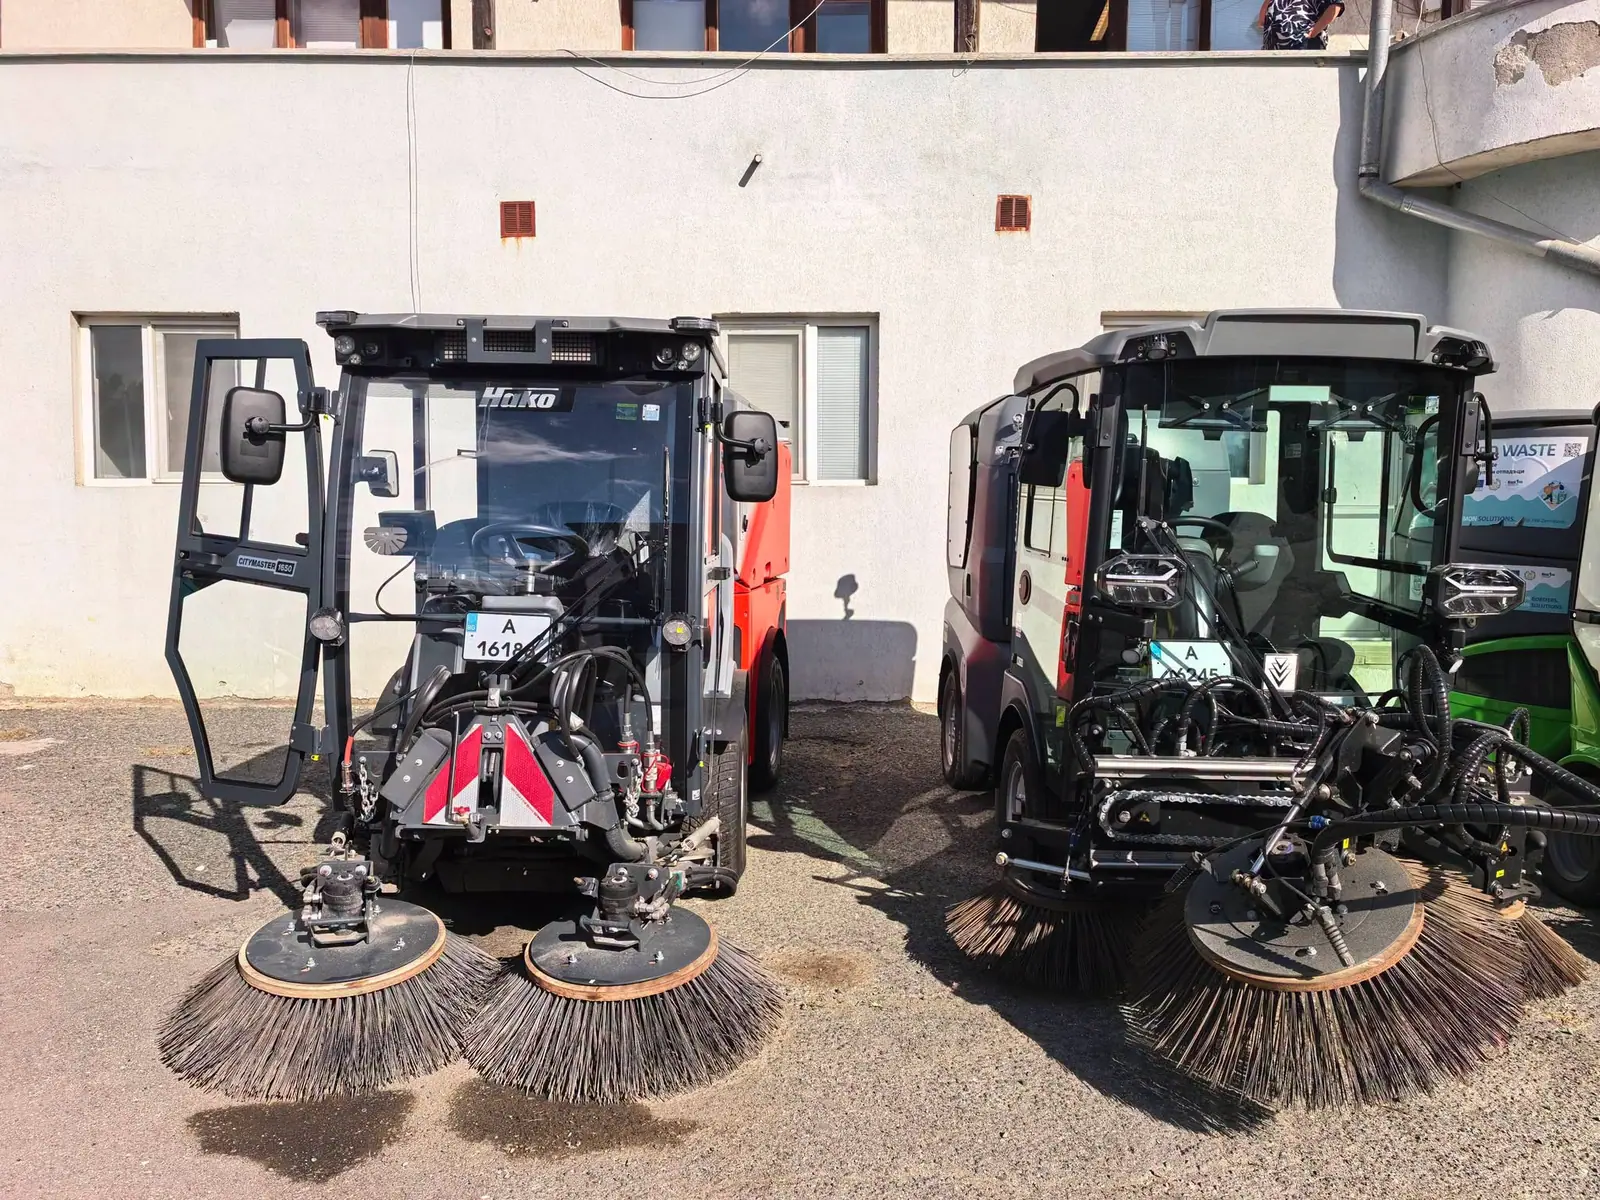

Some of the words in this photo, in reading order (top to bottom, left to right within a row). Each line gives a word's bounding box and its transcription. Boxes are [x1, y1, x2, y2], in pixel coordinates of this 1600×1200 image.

[478, 387, 559, 408] Hako
[1503, 444, 1557, 457] WASTE
[238, 557, 276, 570] CITYMASTER
[278, 563, 293, 573] 1650
[501, 618, 516, 634] A
[1185, 645, 1198, 660] A
